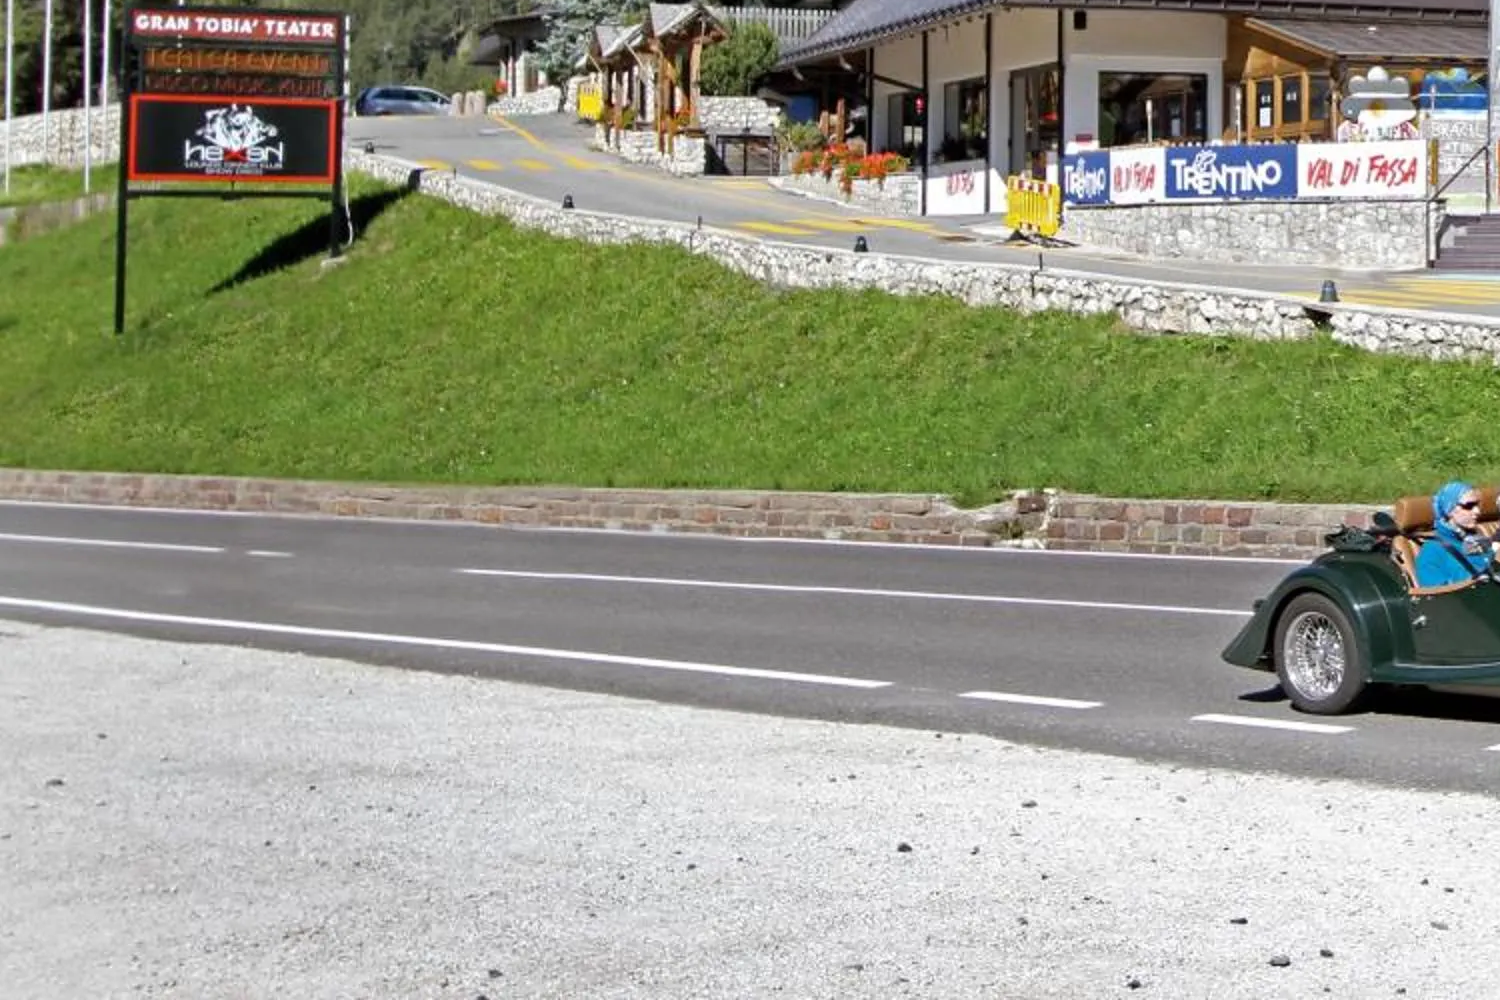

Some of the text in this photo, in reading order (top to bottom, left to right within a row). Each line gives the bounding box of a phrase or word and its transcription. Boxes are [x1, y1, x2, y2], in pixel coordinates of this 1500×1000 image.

[135, 13, 335, 38] GRAN TOBIA' TEATER
[1170, 158, 1282, 195] TRENTINO
[1306, 158, 1335, 188] VAL
[1366, 154, 1418, 188] FASSA
